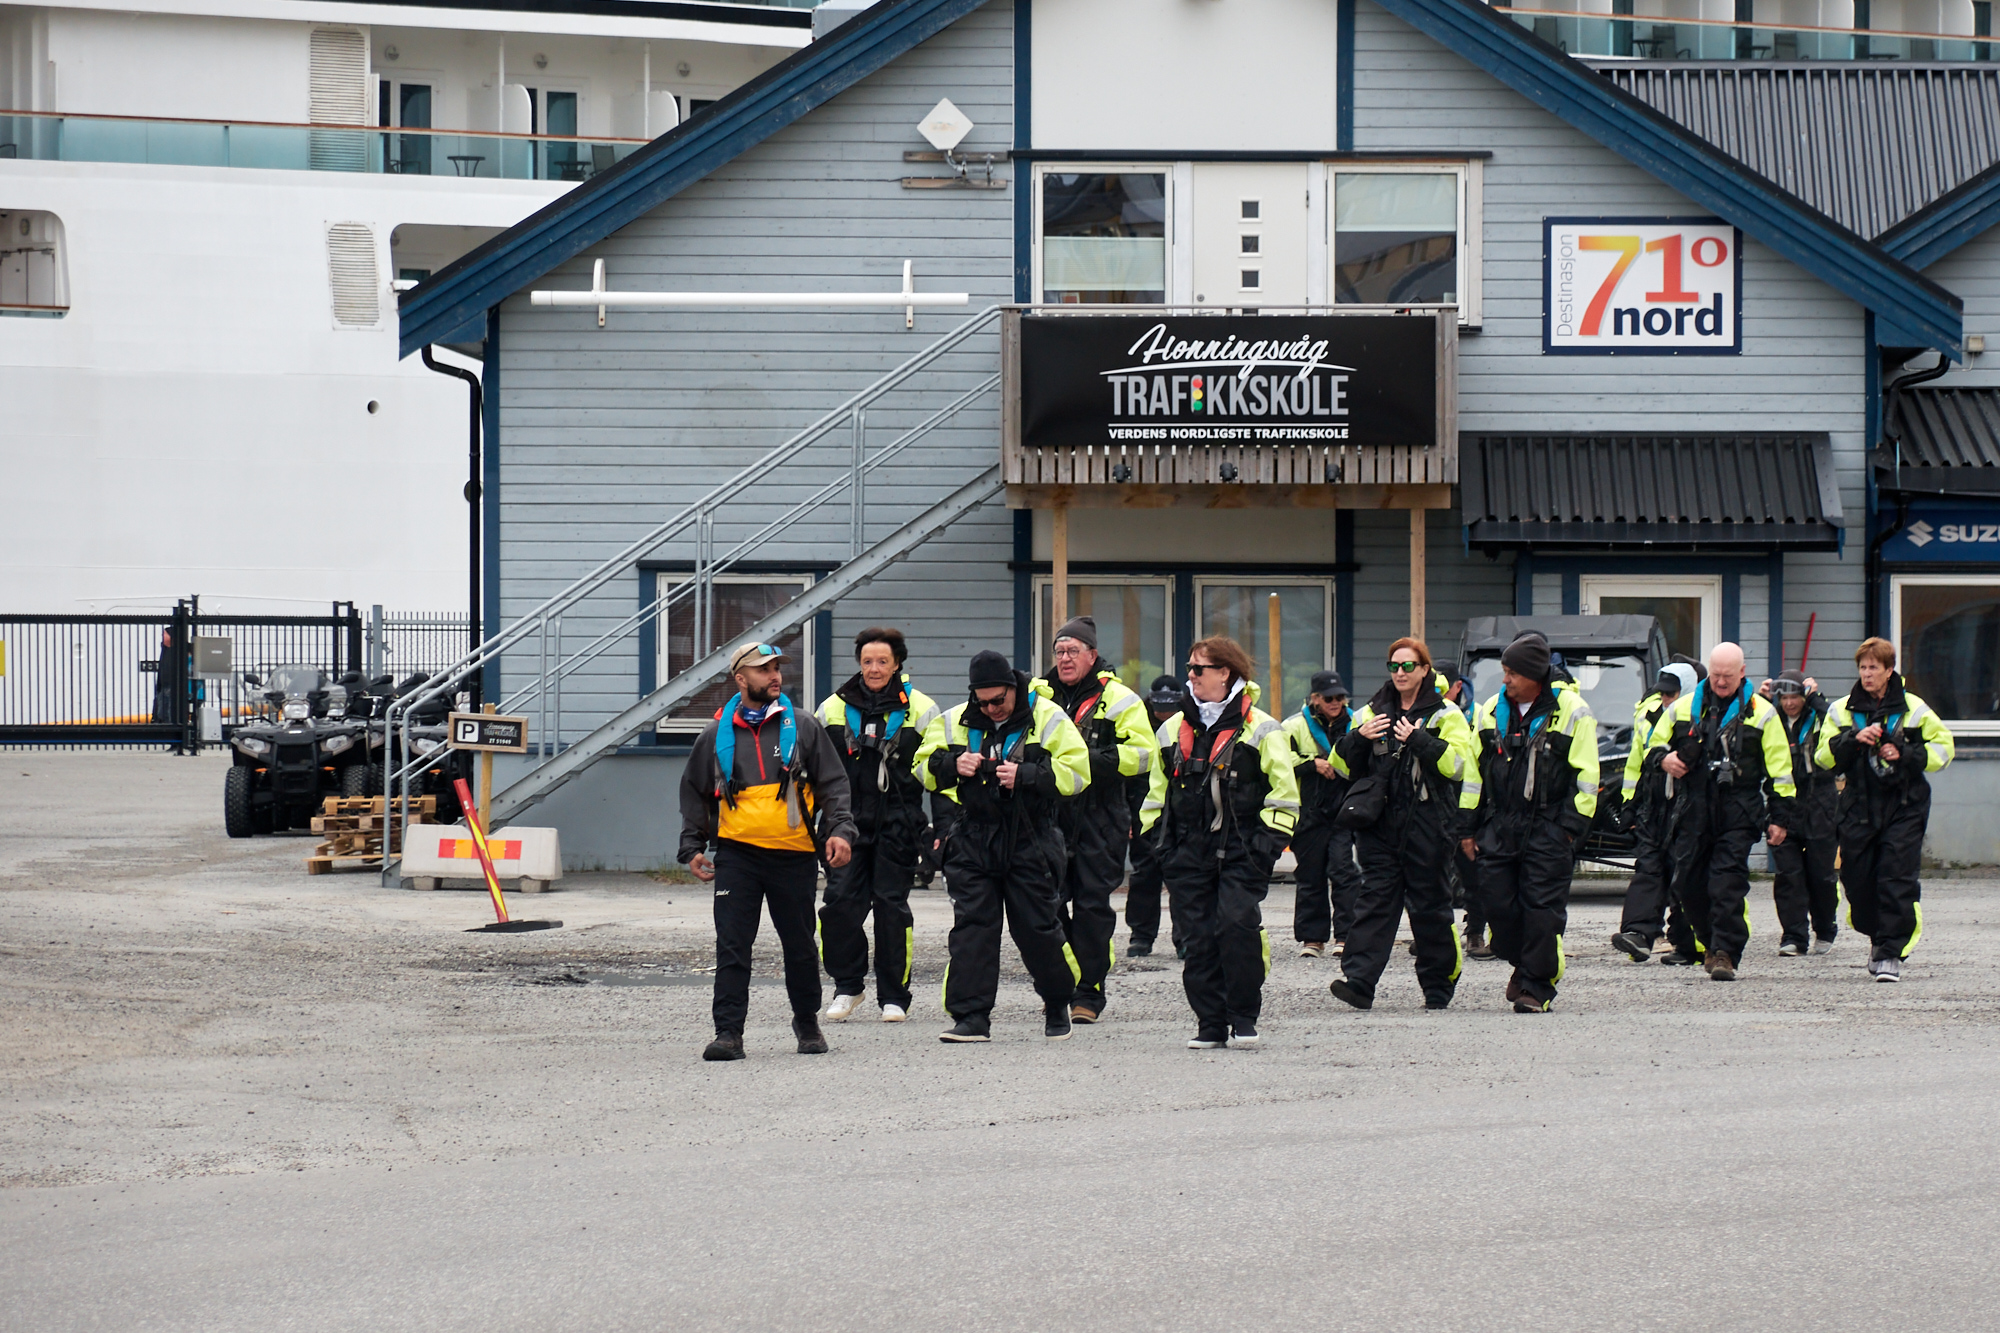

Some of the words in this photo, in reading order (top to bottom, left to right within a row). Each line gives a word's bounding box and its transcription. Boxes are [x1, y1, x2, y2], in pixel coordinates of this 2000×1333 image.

[1556, 234, 1576, 337] Destinasjon
[1613, 292, 1723, 336] nord
[1128, 323, 1329, 380] Honningsvåg
[1108, 428, 1168, 439] VERDENS
[1170, 428, 1251, 439] NORDLIGSTE
[1254, 428, 1349, 439] TRAFIKKSKOLE
[1939, 524, 2000, 543] SUZ
[462, 723, 475, 739] P
